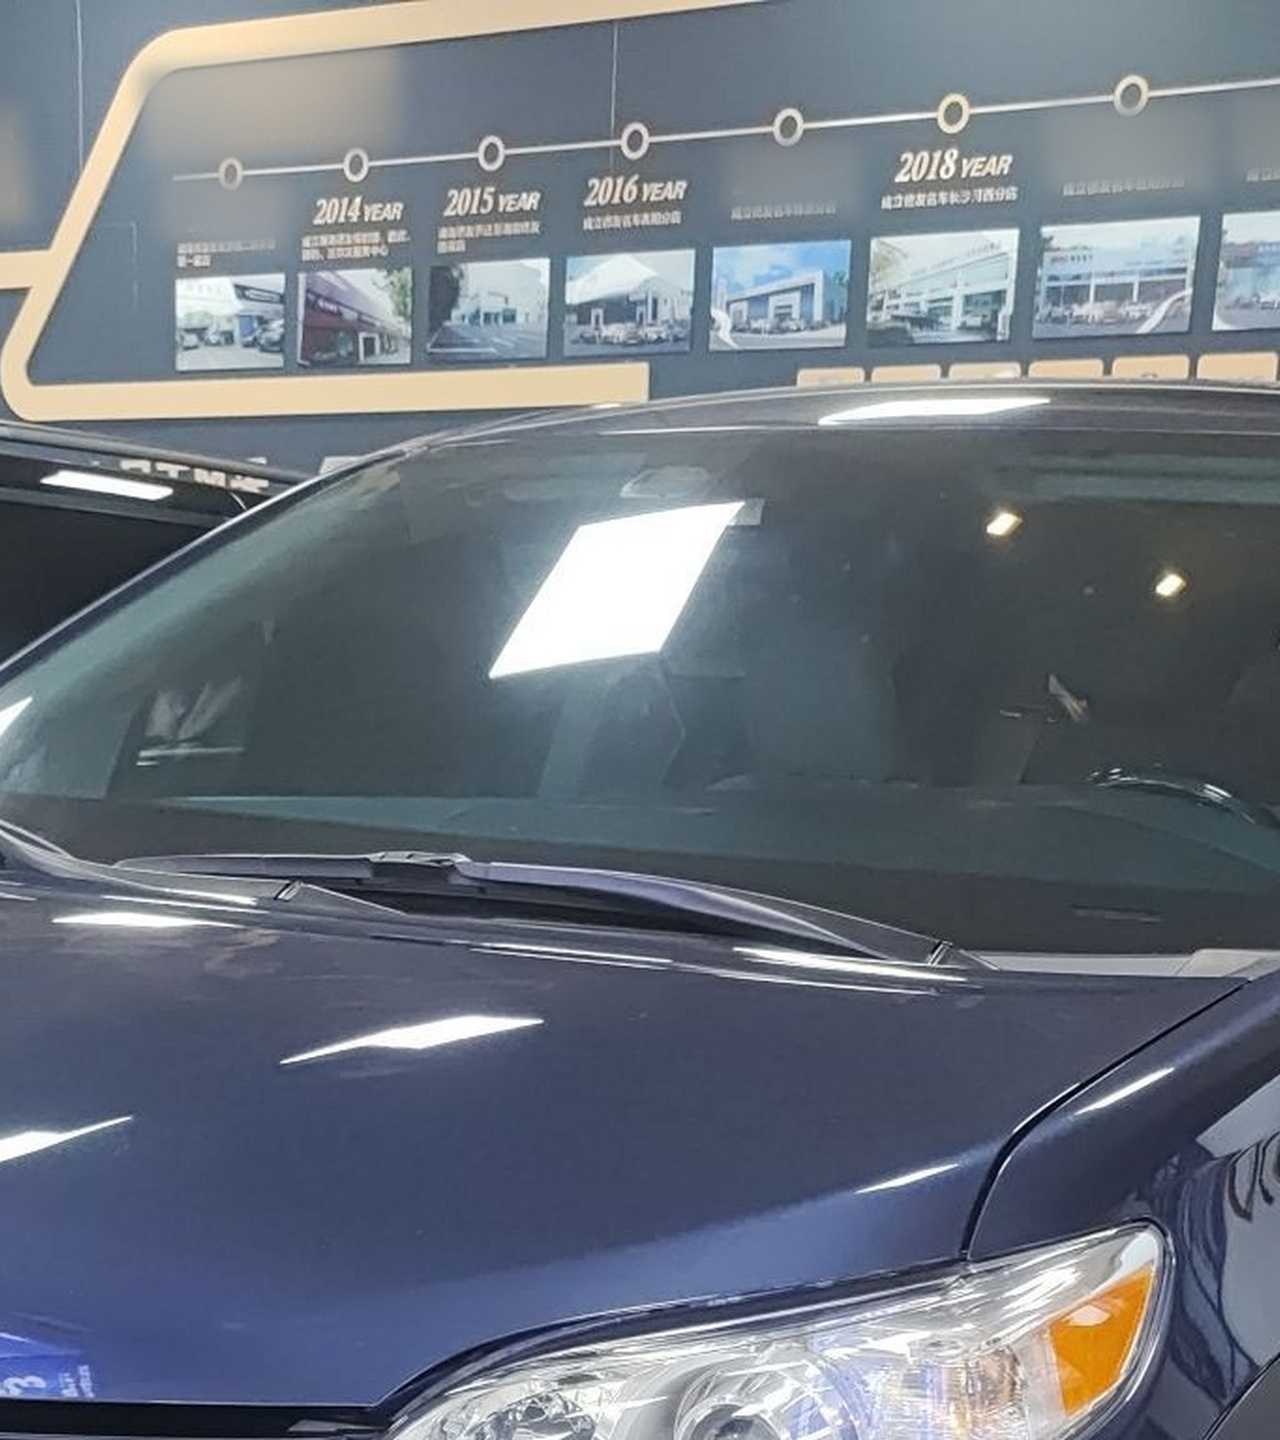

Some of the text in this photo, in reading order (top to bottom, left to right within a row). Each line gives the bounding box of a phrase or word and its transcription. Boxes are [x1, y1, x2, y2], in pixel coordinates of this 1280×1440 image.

[894, 148, 1013, 183] 2018 YEAR
[443, 186, 541, 217] 2015 YEAR
[583, 174, 687, 207] 2016 YEAR
[312, 195, 404, 226] 2014 YEAR
